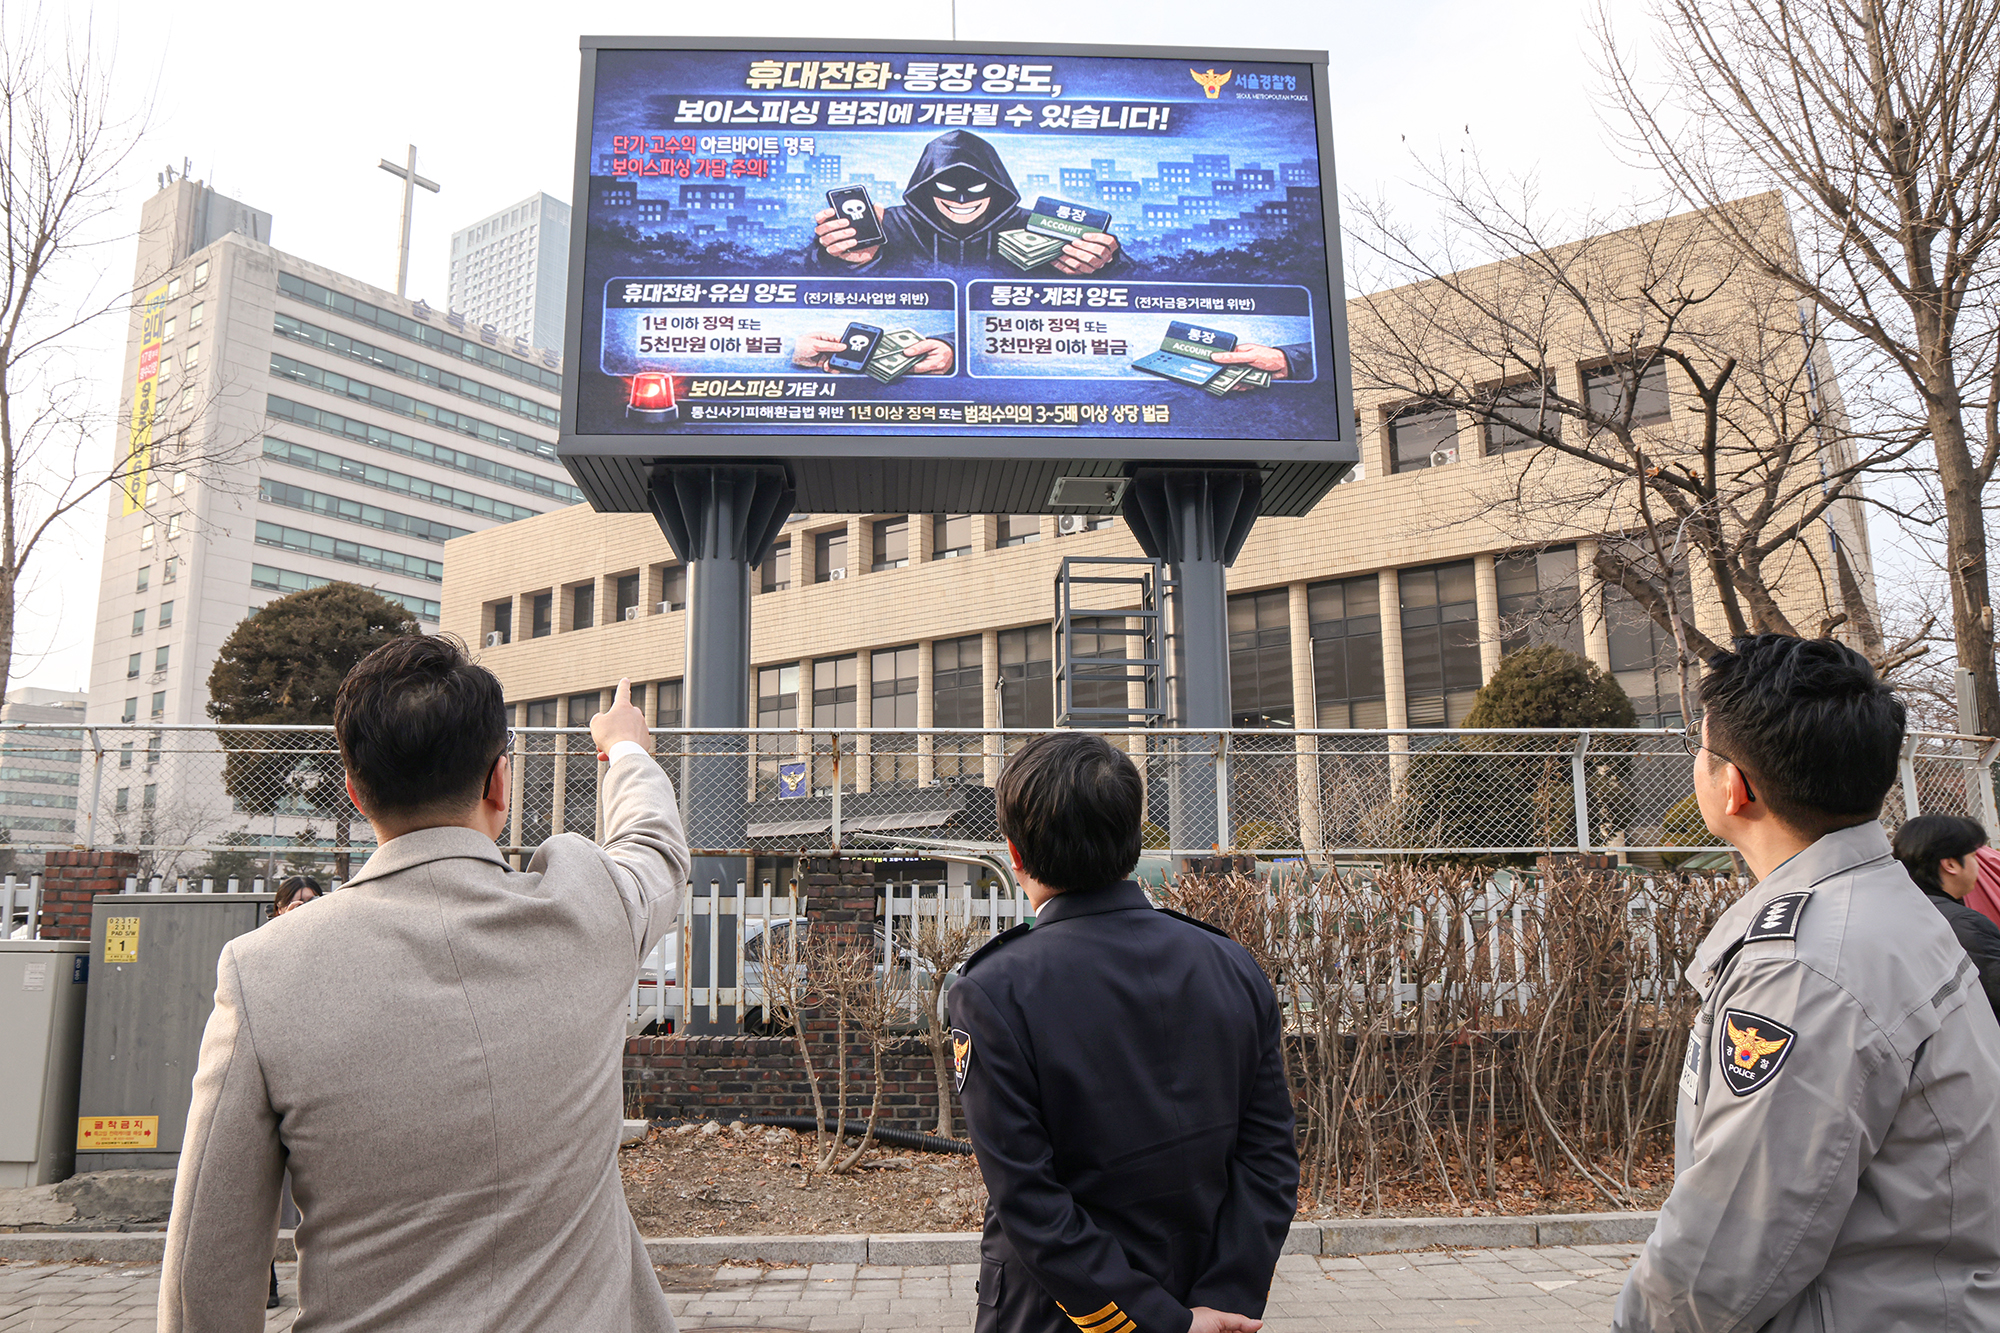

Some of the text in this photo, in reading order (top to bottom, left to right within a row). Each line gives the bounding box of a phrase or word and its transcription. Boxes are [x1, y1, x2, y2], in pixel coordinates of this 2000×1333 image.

[980, 63, 1061, 98] 양도,
[1234, 73, 1296, 91] 서울경찰청
[1235, 92, 1308, 102] SEOUL METROPOLITAN POLICE
[674, 100, 1171, 130] 보이스피싱 범죄에 가담될 수 있습니다!
[613, 135, 815, 156] 단기·고수익 아르바이트 명목
[612, 158, 768, 178] 보이스피싱 가담 주의!
[1056, 205, 1087, 222] 통장
[1040, 218, 1083, 235] ACCOUNT
[754, 284, 797, 303] 양도
[803, 291, 896, 306] (전기통신사업법
[898, 292, 930, 306] 위반)
[1086, 287, 1129, 307] 양도
[1134, 296, 1225, 311] (전자금융거래법
[1226, 297, 1256, 311] 위반)
[143, 309, 164, 345] 임대
[642, 315, 761, 332] 1년 이하 징역 또는
[984, 317, 1107, 334] 5년 이하 징역 또는
[1187, 328, 1216, 344] 통장
[639, 336, 782, 354] 5천만원 이하 벌금
[985, 336, 1128, 356] 3천만원 이하 벌금
[1172, 342, 1213, 357] ACCOUNT
[688, 380, 836, 397] 보이스피싱 가담 시
[690, 404, 1169, 423] 통신사기피해환급법 위반 1년 이상 징역 또는 범죄수익의 3~5배 이상 상당 벌금
[119, 940, 125, 951] 1
[1726, 1045, 1733, 1057] 경
[1728, 1063, 1756, 1080] POLICE
[1760, 1058, 1770, 1070] 찰
